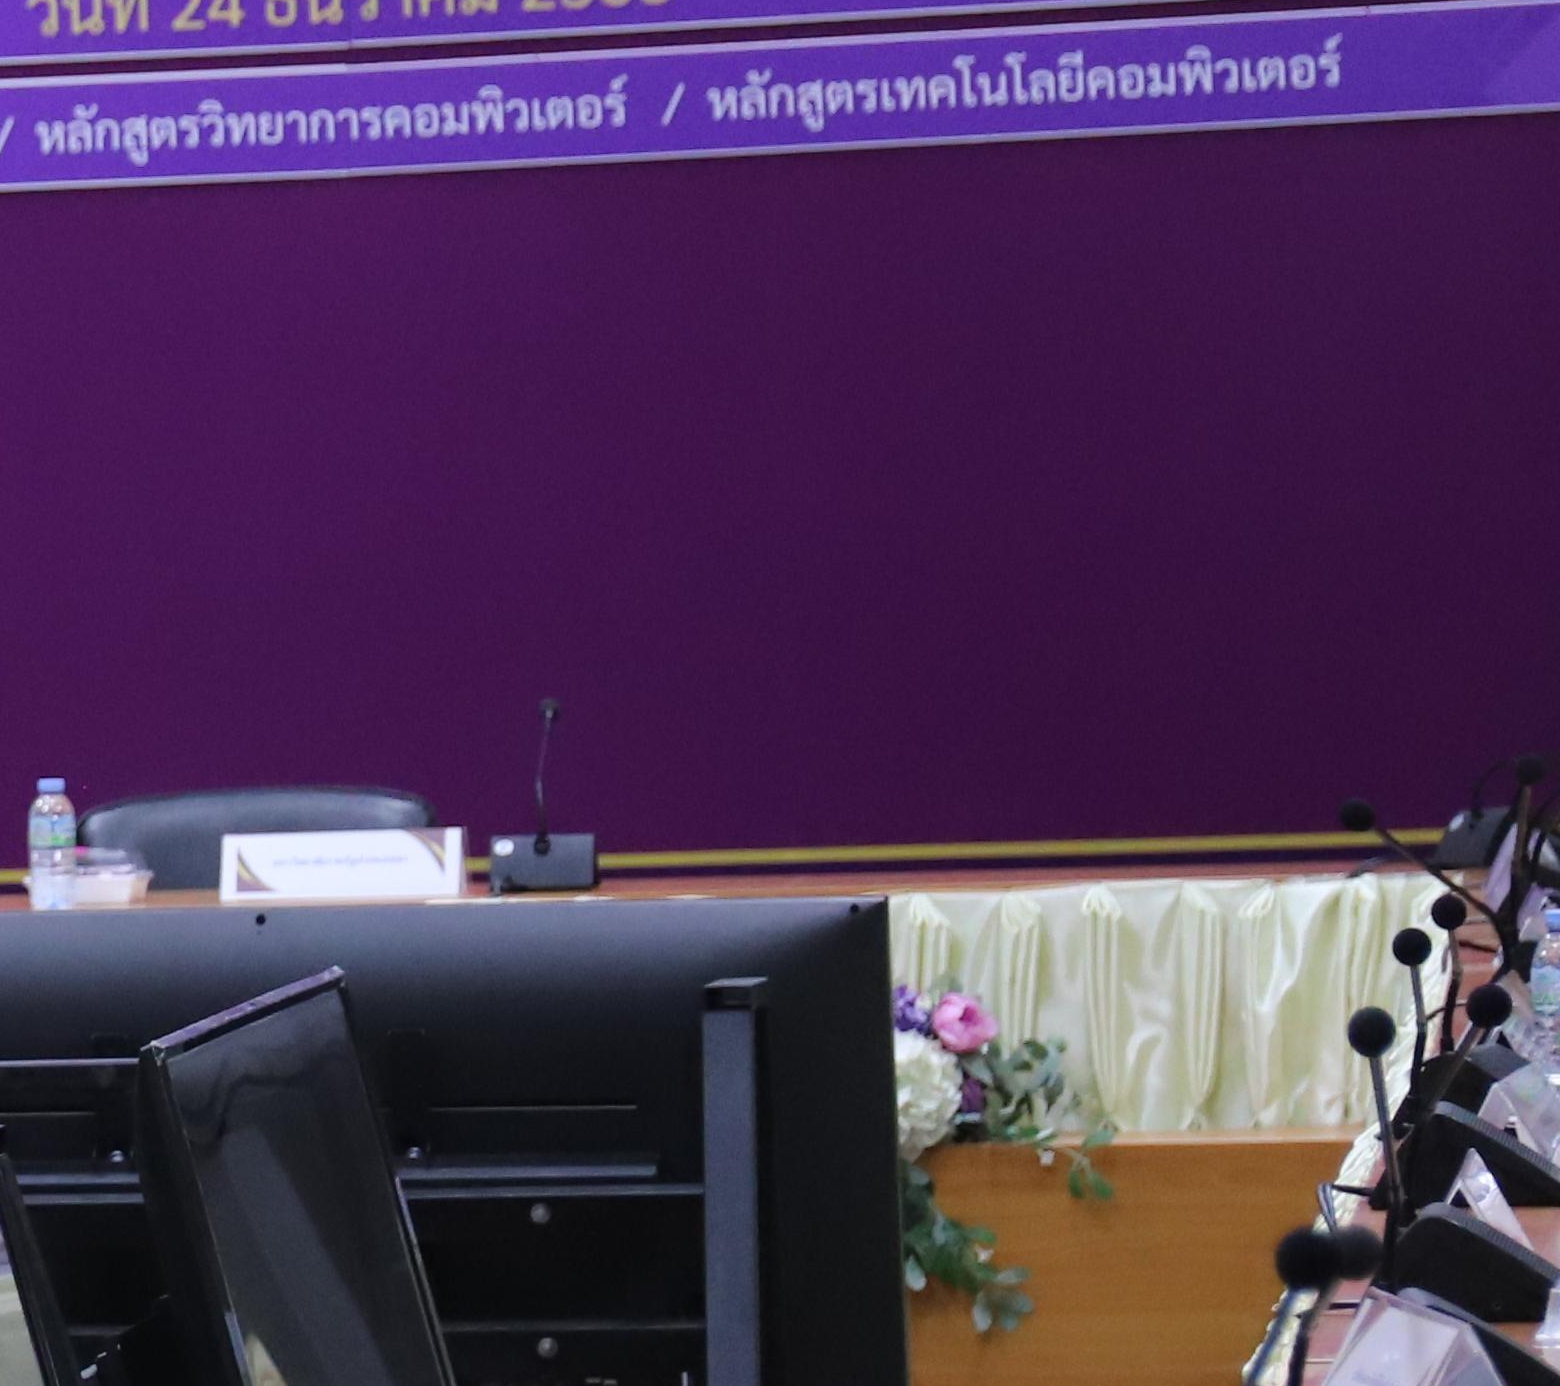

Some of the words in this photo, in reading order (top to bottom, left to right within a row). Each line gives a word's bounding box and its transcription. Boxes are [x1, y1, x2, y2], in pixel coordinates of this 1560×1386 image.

[33, 71, 630, 168] หลักสูตรวิทยาการคอมพิวเตอร์
[659, 81, 687, 127] /
[707, 32, 1344, 133] หลักสูตรเทคโนโลยีคอมพิวเตอร์
